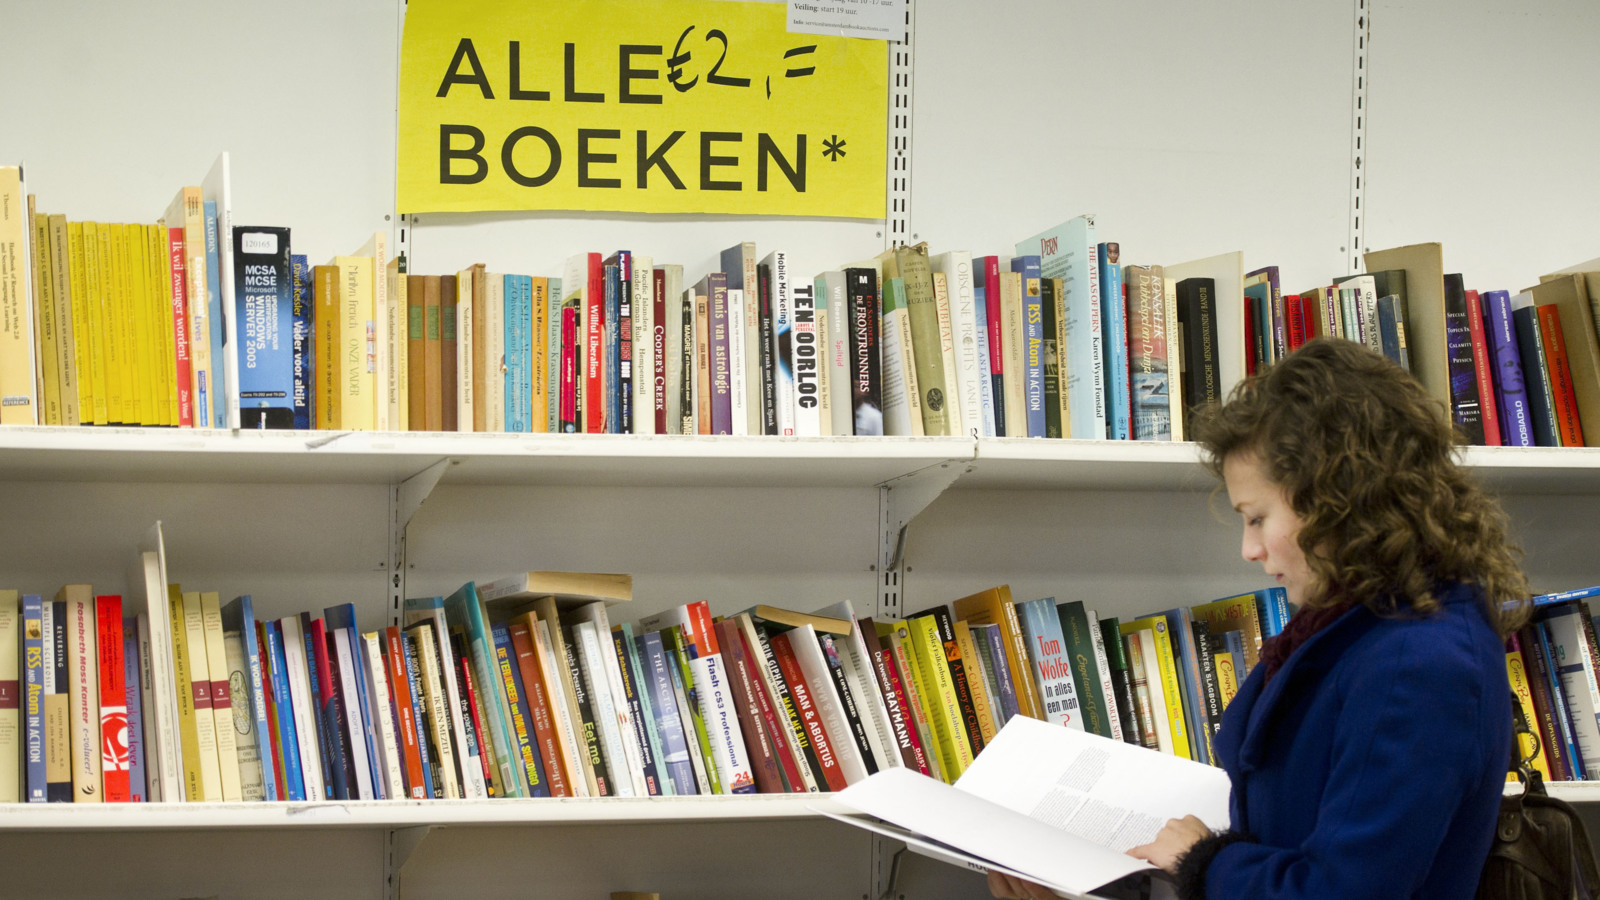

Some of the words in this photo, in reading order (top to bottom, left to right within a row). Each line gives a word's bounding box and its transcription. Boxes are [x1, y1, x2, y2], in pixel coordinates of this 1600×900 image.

[794, 3, 819, 12] Veiling:
[435, 37, 663, 104] ALLE
[172, 241, 183, 251] Ik
[207, 215, 216, 253] ALADDIN
[172, 254, 184, 271] wil
[777, 253, 786, 280] Mobile
[1088, 246, 1096, 263] THE
[245, 265, 277, 275] MCSA
[245, 276, 277, 286] MCSE
[293, 263, 302, 286] David
[348, 265, 359, 297] Marilyn
[1089, 265, 1098, 294] ATLAS
[172, 273, 185, 316] zwanger
[294, 288, 302, 316] Kessler
[714, 286, 727, 319] Kennis
[778, 282, 787, 324] Marketing
[794, 285, 814, 323] TEN
[834, 286, 842, 298] Wil
[857, 295, 863, 304] DE
[867, 295, 872, 307] ED
[1090, 296, 1098, 308] OF
[1138, 274, 1150, 327] Dubbelspel
[246, 295, 255, 337] SERVER
[348, 300, 358, 329] French
[590, 305, 599, 333] Willful
[834, 301, 842, 333] Boesten
[936, 278, 952, 352] SHAMBHALA
[1028, 304, 1040, 324] RSS
[1091, 309, 1099, 332] PERN
[1152, 275, 1164, 340] KONSALIK
[256, 295, 265, 350] WINDOWS
[293, 321, 303, 351] Vader
[715, 324, 725, 340] van
[1142, 328, 1150, 343] om
[177, 318, 188, 360] worden!
[350, 338, 358, 364] ONZE
[857, 307, 870, 393] FRONTRUNNERS
[1029, 337, 1041, 366] Atom
[1092, 337, 1101, 360] Karen
[247, 340, 256, 368] 2003
[294, 353, 303, 377] voor
[590, 336, 598, 378] Liberalism
[836, 340, 844, 367] Spiltijd
[1139, 344, 1154, 374] Dunja
[350, 367, 359, 396] VADER
[714, 346, 730, 394] astrologie
[796, 332, 817, 408] OORLOG
[978, 352, 989, 409] ANTARCTIC
[1030, 368, 1039, 377] IN
[1092, 362, 1101, 386] Wynn
[294, 380, 305, 406] altijd
[655, 376, 664, 410] CREEK
[1030, 380, 1040, 411] ACTION
[1095, 388, 1103, 418] Fonstad
[76, 602, 86, 654] Rosabeth
[941, 614, 952, 640] HEYWOOD
[27, 647, 41, 669] RSS
[250, 654, 257, 663] IK
[874, 651, 884, 662] De
[928, 628, 938, 648] Violet
[933, 649, 948, 688] Falkenburg
[1037, 636, 1061, 656] Tom
[1199, 634, 1211, 672] MAARTEN
[28, 669, 36, 682] AND
[79, 656, 87, 684] Moss
[252, 664, 260, 687] WORD
[757, 632, 772, 659] KARIN
[767, 660, 788, 694] GIPHART
[878, 663, 892, 691] tweede
[953, 664, 963, 672] A
[1038, 656, 1069, 680] Wolfe
[653, 653, 661, 674] THE
[658, 676, 671, 713] ARCTIC
[794, 684, 811, 710] MAN
[956, 673, 970, 703] History
[1045, 685, 1053, 698] In
[1054, 682, 1073, 695] alles
[1204, 673, 1218, 716] SLAGBOOM
[28, 683, 42, 714] Atom
[81, 686, 89, 724] Kanter
[125, 685, 138, 718] Wraak
[253, 689, 265, 721] MOEDER!
[460, 700, 469, 711] the
[964, 705, 973, 714] of
[1047, 700, 1061, 714] een
[1062, 697, 1078, 710] man
[29, 716, 39, 727] IN
[433, 696, 440, 704] IK
[438, 724, 449, 755] MEZELF
[462, 713, 473, 732] spark
[706, 658, 719, 688] Flash
[714, 691, 724, 709] CS3
[720, 711, 739, 768] Professional
[805, 711, 814, 720] &
[885, 691, 911, 748] RAYMANN
[1141, 696, 1154, 733] ABOMINATION
[127, 720, 138, 739] doet
[464, 734, 474, 747] gap
[582, 721, 596, 743] Eet
[1548, 723, 1560, 758] OPVANGGIDS
[29, 729, 41, 763] ACTION
[129, 741, 139, 766] leven
[588, 745, 601, 765] me
[808, 721, 834, 768] ABORTUS
[915, 748, 926, 768] DAISY
[734, 770, 750, 784] 24
